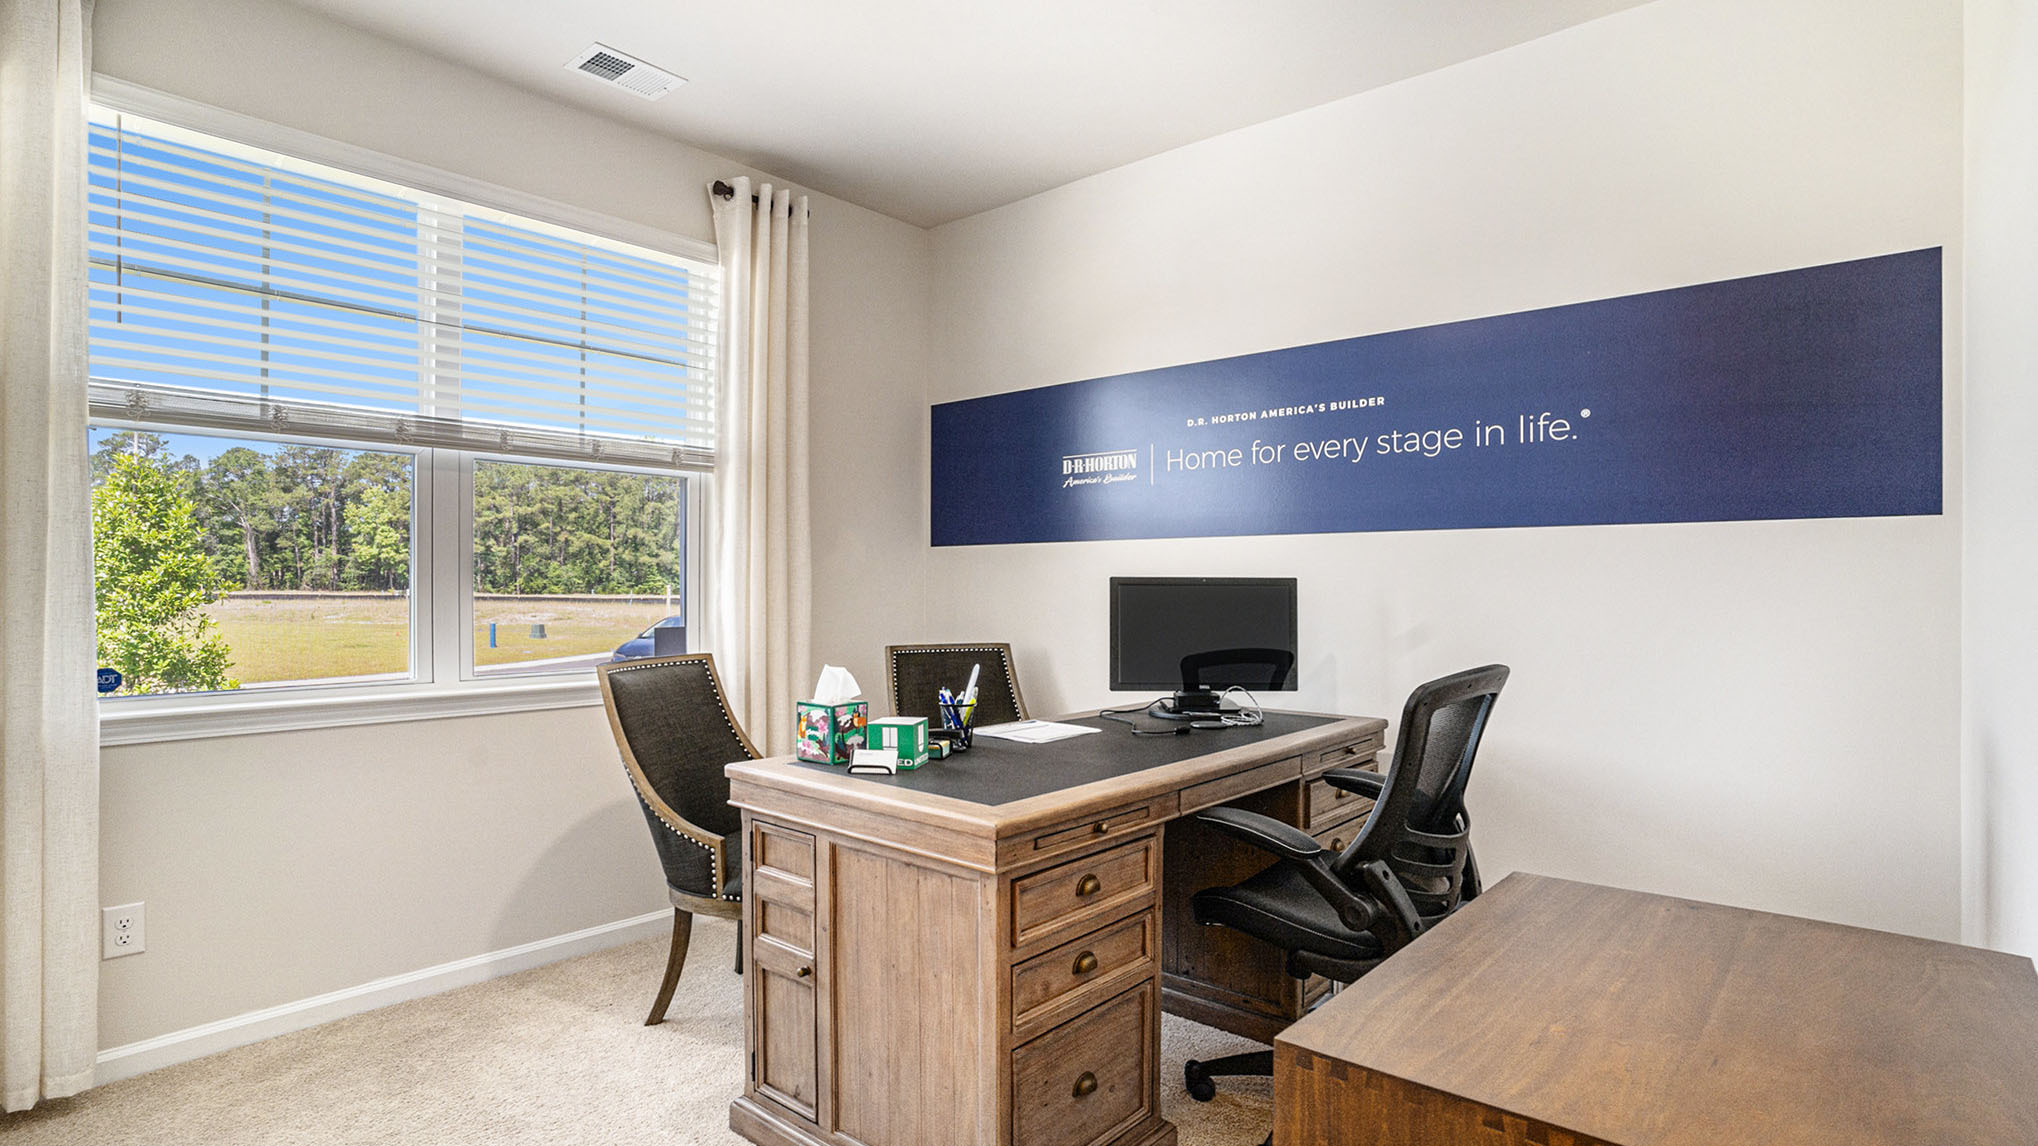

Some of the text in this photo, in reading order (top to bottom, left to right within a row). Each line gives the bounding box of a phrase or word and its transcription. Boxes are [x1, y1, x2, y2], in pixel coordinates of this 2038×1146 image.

[1187, 397, 1385, 427] D.R. HORTON AMERICA'S BUILDER
[1166, 448, 1242, 472] Home
[1251, 440, 1286, 465] for
[1293, 437, 1369, 463] every
[1376, 429, 1463, 457] stage
[1475, 420, 1505, 446] in
[1103, 473, 1137, 484] Builder
[98, 674, 118, 684] ADT
